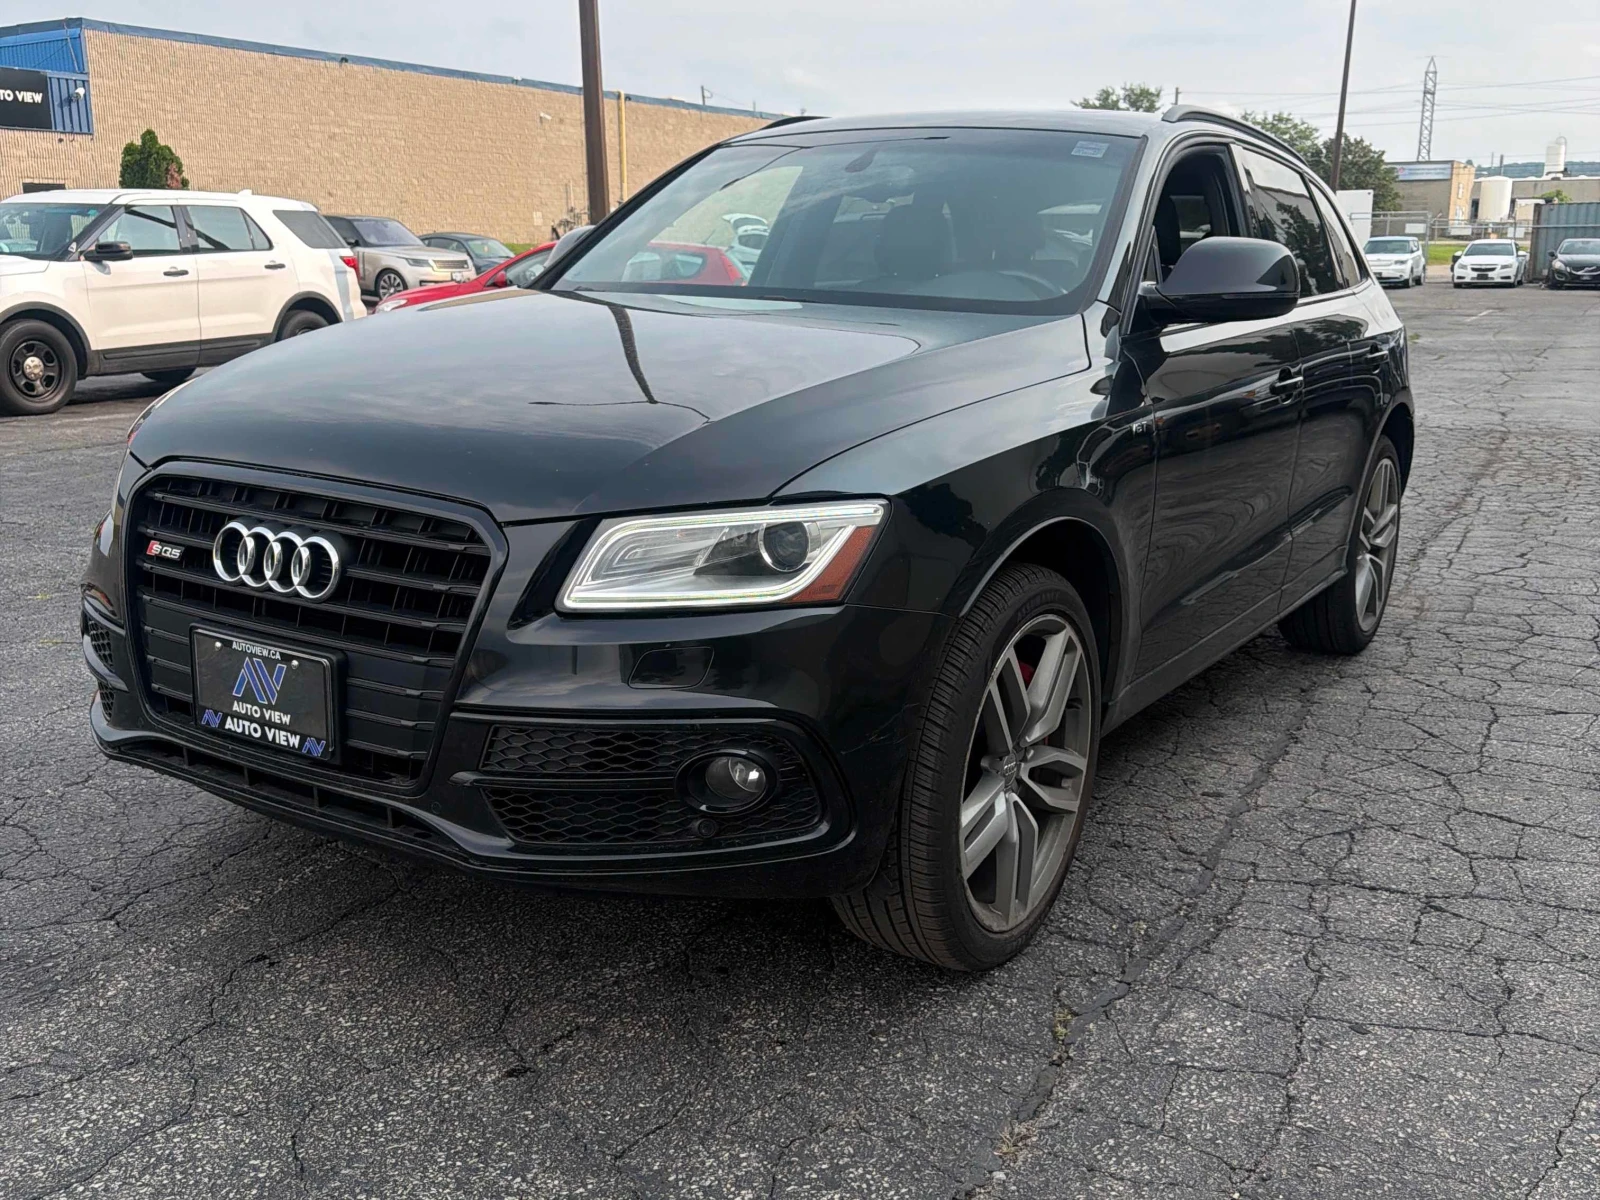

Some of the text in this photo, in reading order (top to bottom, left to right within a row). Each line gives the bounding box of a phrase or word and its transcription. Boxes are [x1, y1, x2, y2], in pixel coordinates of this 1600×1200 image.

[15, 90, 43, 104] VIEW
[232, 641, 281, 660] AUTOVIEW.CA
[232, 700, 291, 726] AUTO VIEW
[224, 716, 262, 738] AUTO
[264, 726, 301, 749] VIEW
